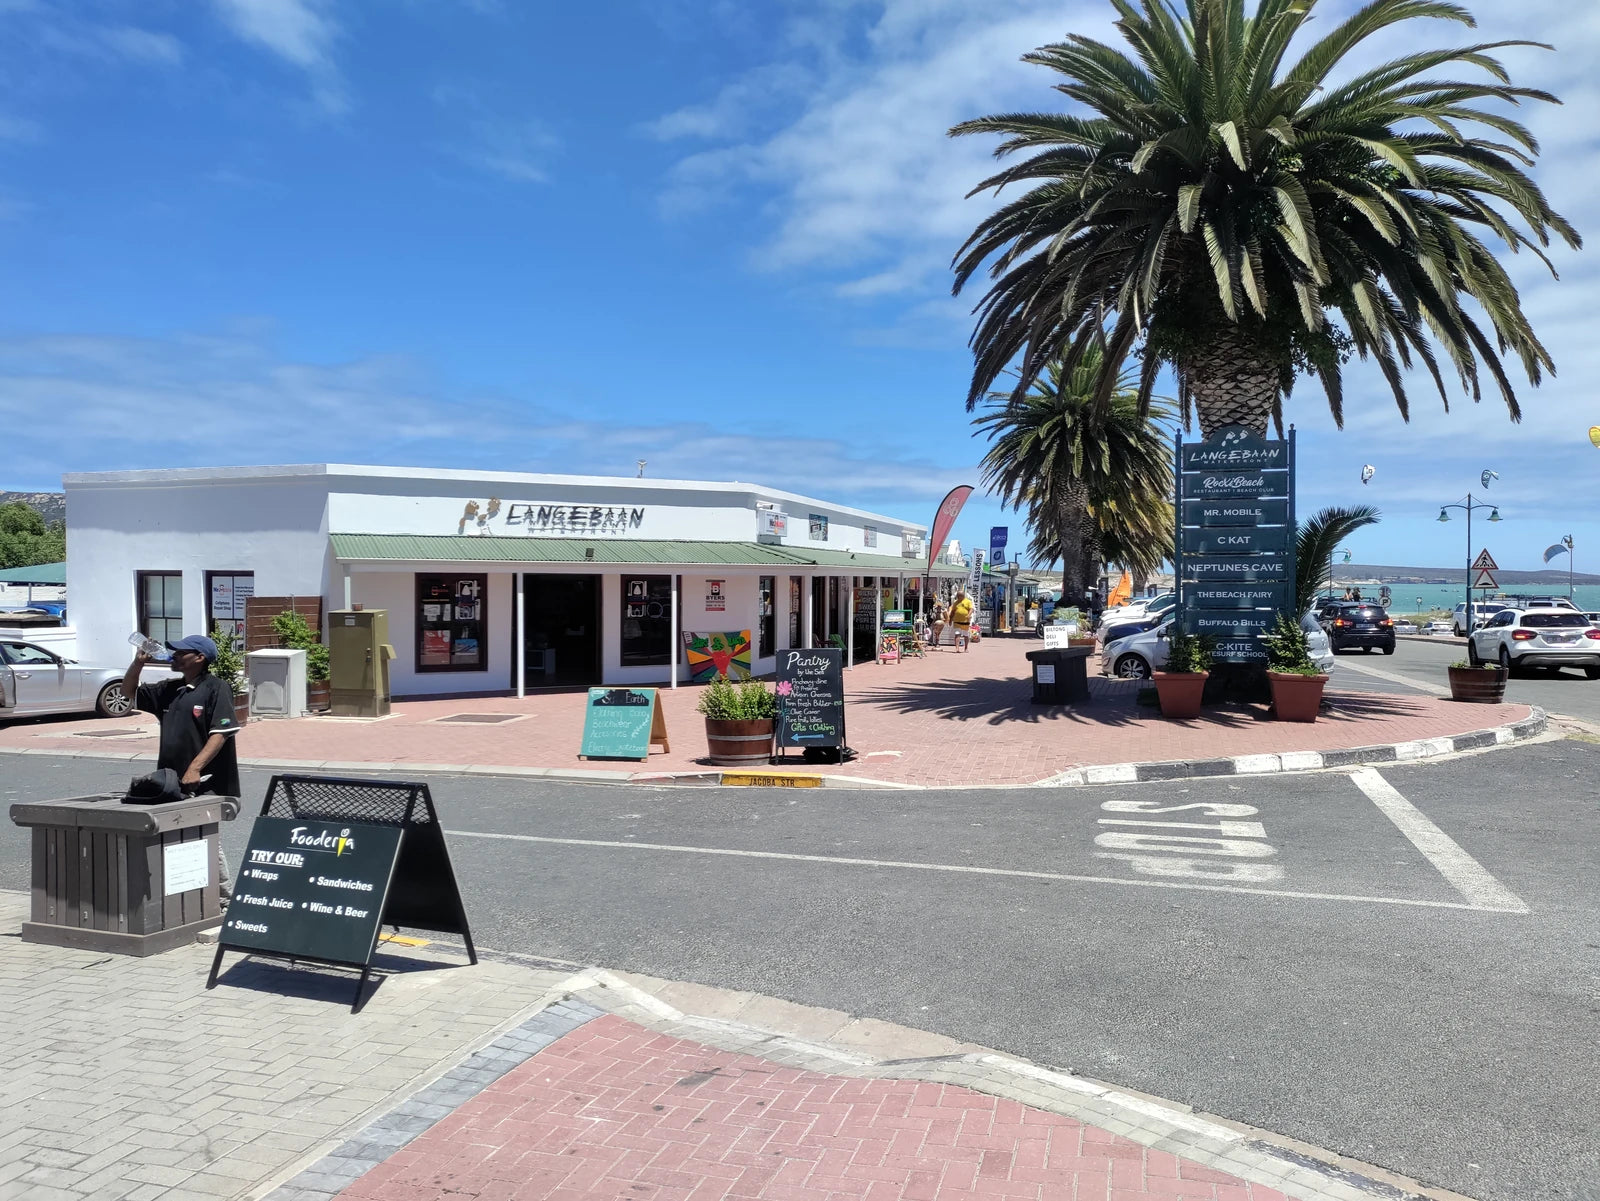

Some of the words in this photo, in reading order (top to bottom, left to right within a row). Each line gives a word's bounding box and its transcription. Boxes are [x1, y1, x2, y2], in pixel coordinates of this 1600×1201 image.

[1190, 448, 1280, 462] LANGEBAAN
[506, 503, 646, 524] LANGEBAAN
[1203, 509, 1222, 517] MR.
[1223, 508, 1263, 517] MOBILE
[1217, 536, 1226, 545] C
[1228, 535, 1252, 544] KAT
[973, 553, 984, 582] LESSONS
[1187, 563, 1249, 572] NEPTUNES
[1251, 563, 1284, 572] CAVE
[1196, 591, 1215, 599] THE
[1216, 591, 1245, 599] BEACH
[1247, 591, 1273, 599] FAIRY
[1215, 642, 1253, 651] C-KITE
[787, 651, 831, 671] Pantry
[797, 668, 804, 677] by
[814, 668, 825, 676] Sea
[790, 722, 806, 732] Gifts
[812, 722, 836, 735] Clothing
[749, 777, 776, 787] JACOBA
[781, 778, 795, 788] STR
[290, 826, 355, 857] Fooderia
[251, 849, 275, 862] TRY
[276, 852, 304, 866] OUR:
[251, 868, 279, 882] Wraps
[316, 876, 374, 892] Sandwiches
[243, 894, 268, 906] Fresh
[268, 897, 294, 910] Juice
[309, 901, 334, 915] Wine
[335, 905, 343, 916] &
[344, 906, 369, 919] Beer
[234, 920, 268, 934] Sweets
